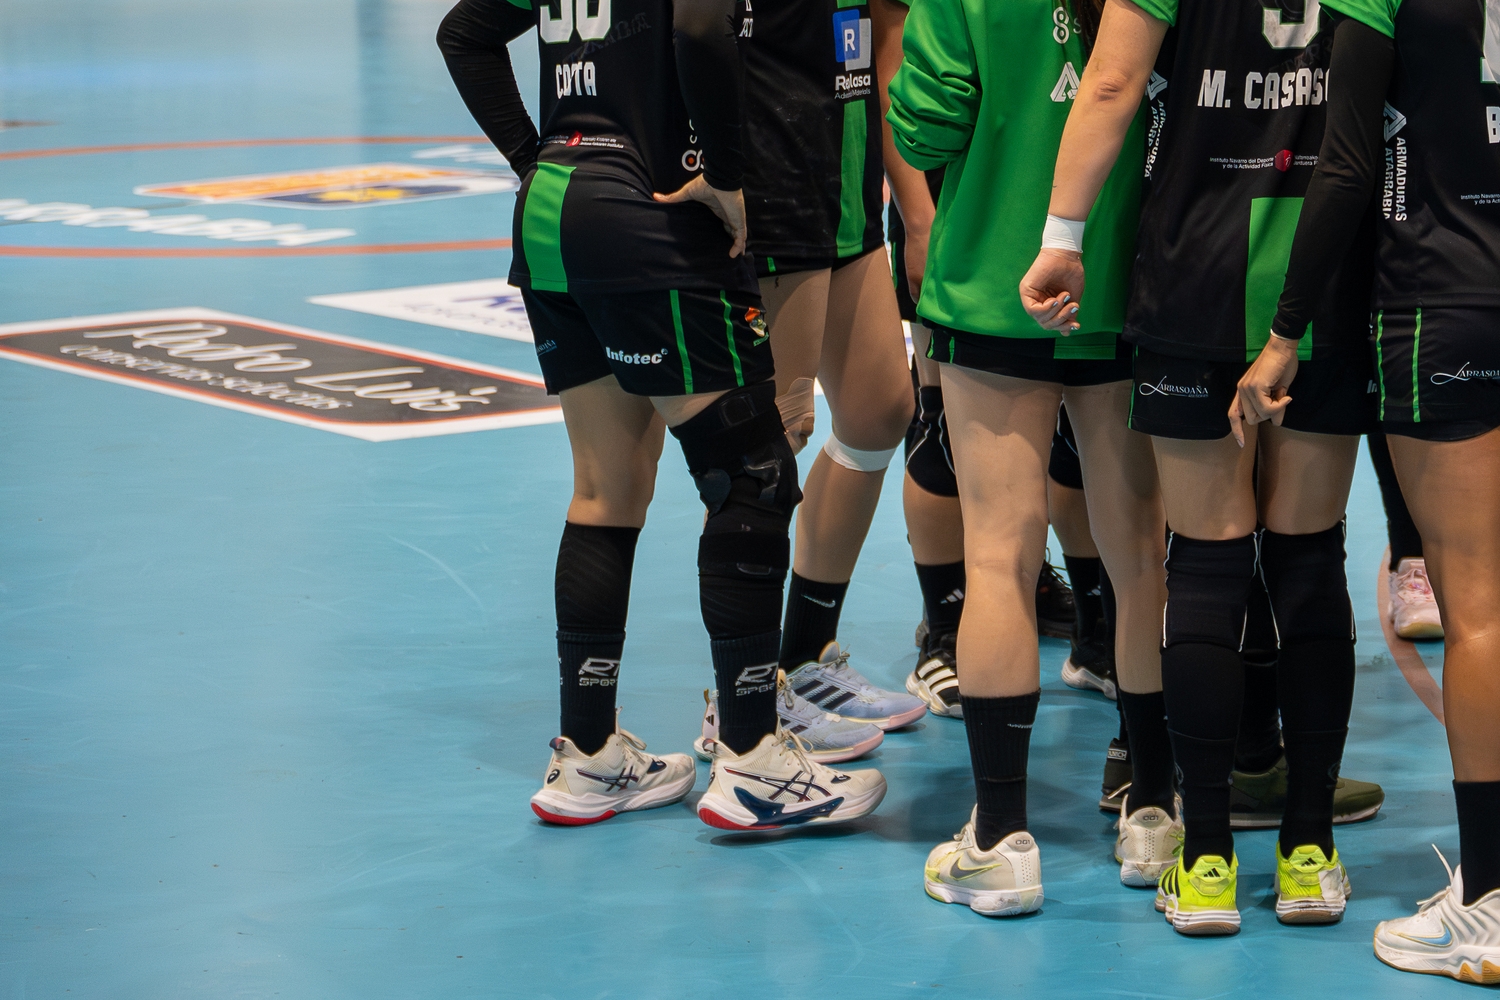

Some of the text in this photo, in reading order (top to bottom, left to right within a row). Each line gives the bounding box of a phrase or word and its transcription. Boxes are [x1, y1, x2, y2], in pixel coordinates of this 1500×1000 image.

[844, 28, 856, 51] R
[555, 61, 597, 99] COTA
[1197, 67, 1330, 110] M. CASAS
[1395, 137, 1408, 222] ARMADURAS
